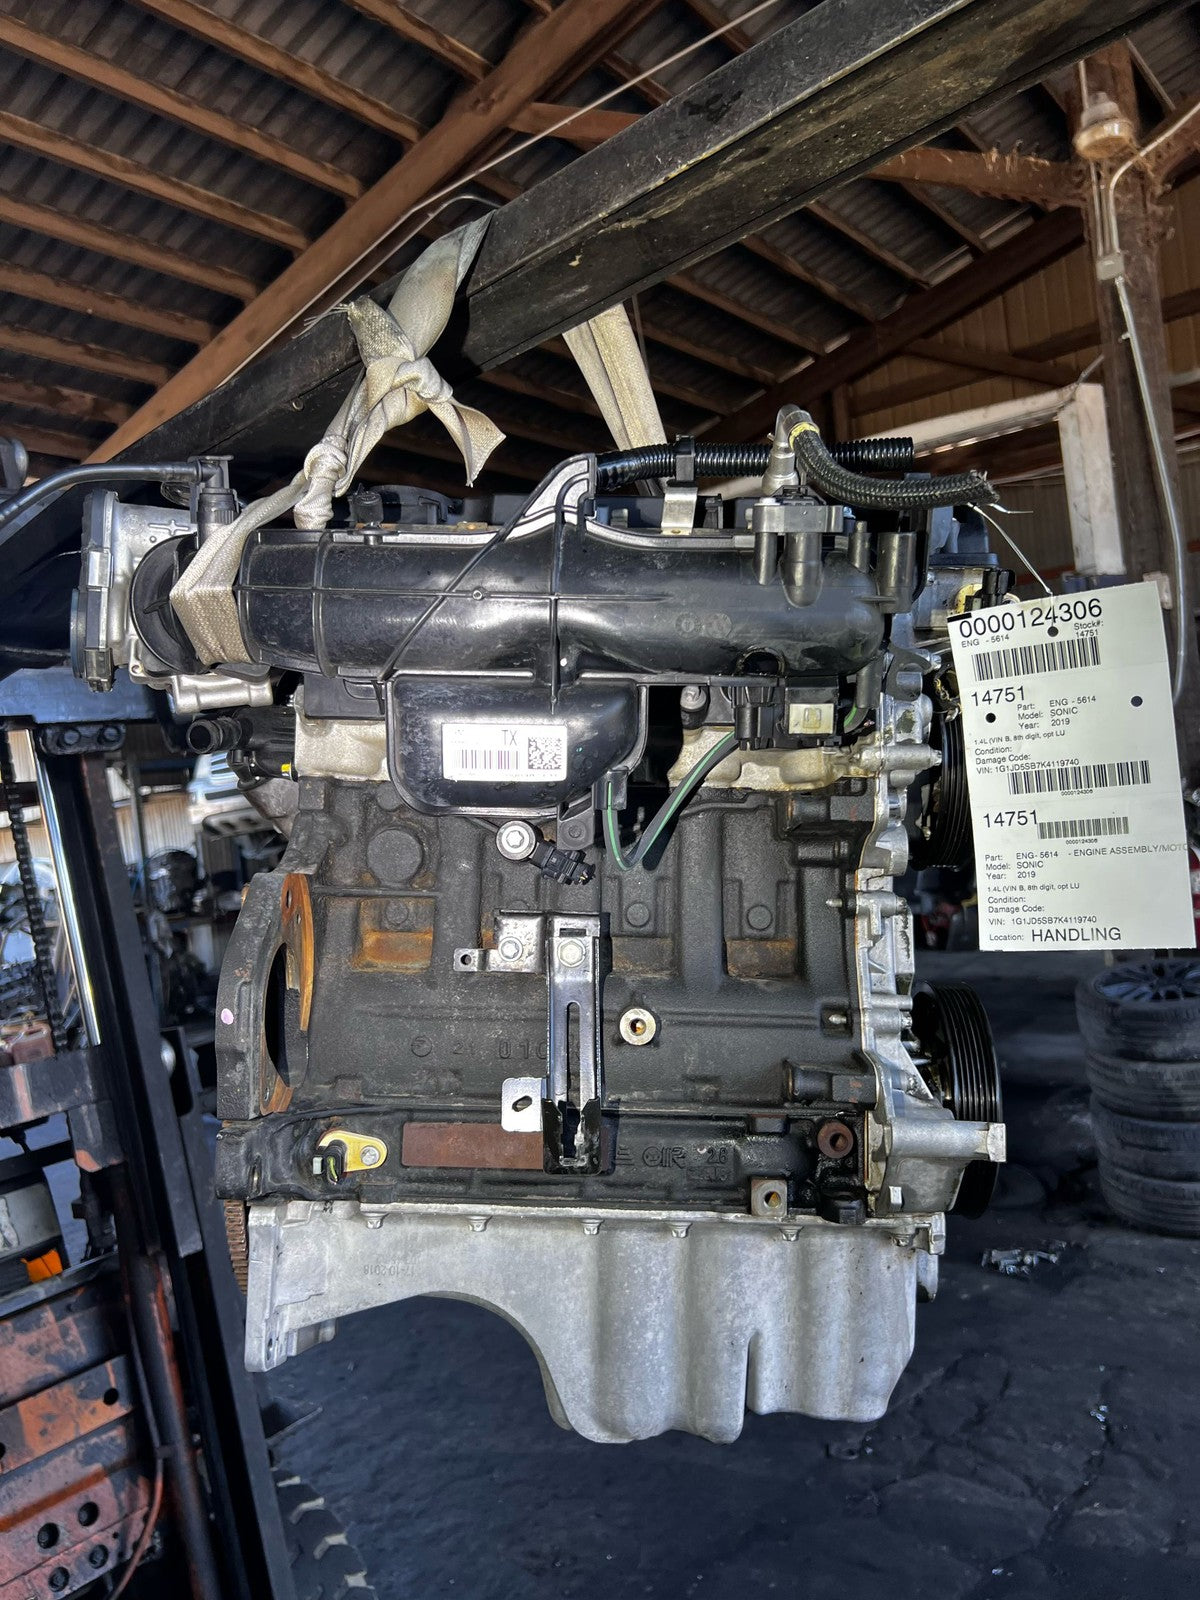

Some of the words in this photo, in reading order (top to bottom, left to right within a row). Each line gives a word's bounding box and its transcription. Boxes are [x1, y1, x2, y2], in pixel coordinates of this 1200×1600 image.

[959, 598, 1103, 638] 0000124306
[1073, 620, 1104, 631] Stock#:
[1075, 629, 1099, 638] 14751
[961, 640, 980, 648] ENG
[991, 635, 1010, 643] 5614
[971, 686, 1026, 707] 14751
[1017, 703, 1036, 711] Part:
[1049, 699, 1069, 707] ENG
[1077, 696, 1097, 704] 5614
[1018, 711, 1044, 720] Model:
[1050, 707, 1079, 717] SONIC
[1018, 722, 1040, 730] Year:
[1051, 718, 1071, 727] 2019
[501, 729, 518, 746] TX
[989, 736, 1003, 745] (VIN
[1043, 731, 1055, 740] opt
[974, 746, 1013, 756] Condition:
[975, 756, 1006, 766] Damage
[1008, 754, 1031, 763] Code:
[976, 767, 993, 775] VIN:
[983, 809, 1038, 828] 14751
[985, 854, 1003, 862] Part:
[1039, 851, 1059, 859] 5614
[1073, 848, 1108, 857] ENGINE
[985, 862, 1011, 871] Model:
[1016, 861, 1044, 869] SONIC
[986, 872, 1007, 880] Year:
[1017, 871, 1036, 879] 2019
[1002, 885, 1017, 893] (VIN
[1027, 883, 1038, 891] 8th
[1039, 883, 1055, 892] digit,
[1057, 883, 1069, 891] opt
[988, 896, 1026, 904] Condition:
[988, 905, 1020, 914] Damage
[1022, 904, 1045, 913] Code:
[989, 918, 1005, 926] VIN:
[1011, 916, 1097, 925] 1G1JD5SB7K4119740
[989, 934, 1024, 942] Location:
[1032, 926, 1121, 942] HANDLING
